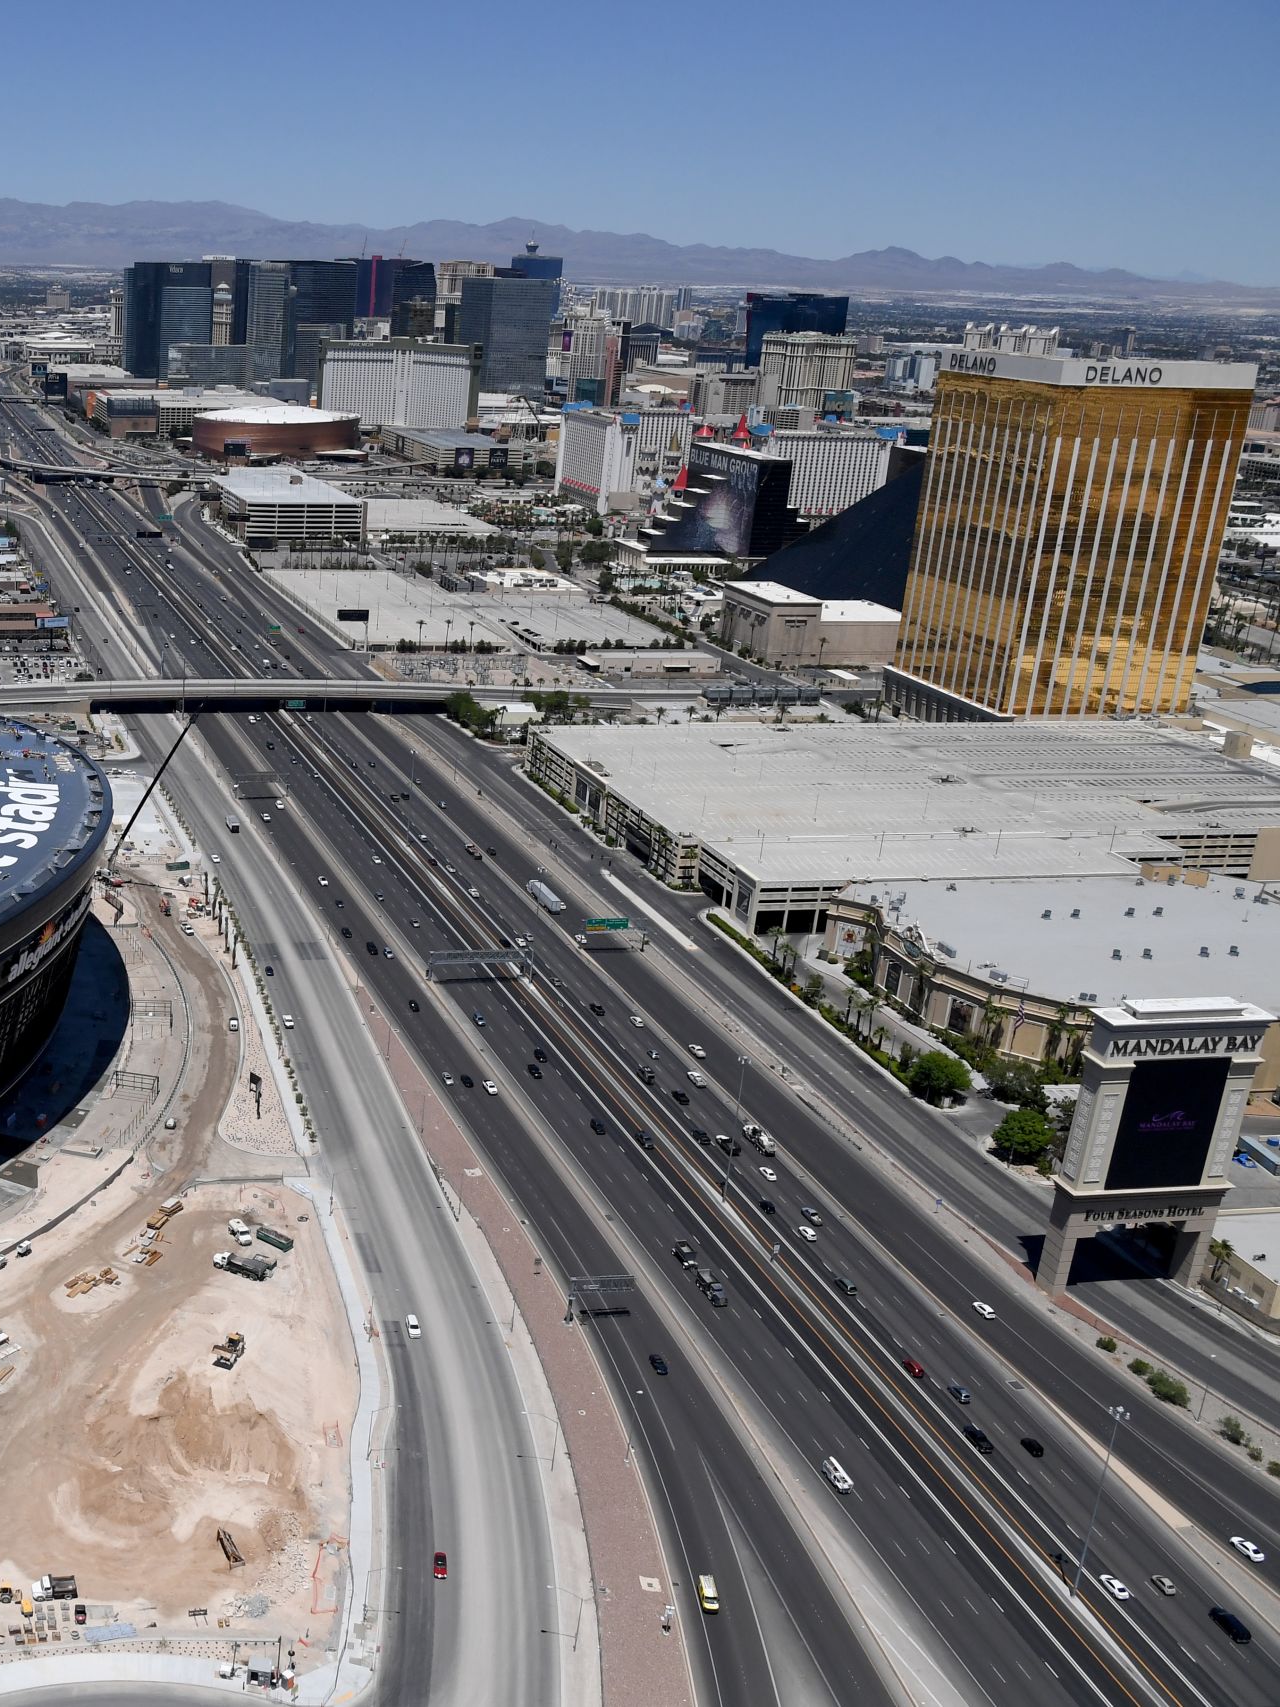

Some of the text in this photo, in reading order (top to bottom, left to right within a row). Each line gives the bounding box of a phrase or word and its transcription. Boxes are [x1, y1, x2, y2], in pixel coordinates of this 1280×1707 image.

[950, 353, 996, 374] DELANO
[1085, 366, 1163, 384] DELANO
[825, 401, 854, 412] MGM
[690, 448, 758, 476] BLUE MAN GROUP
[8, 923, 64, 982] allegiant
[1110, 1035, 1263, 1058] MANDALAY BAY
[1084, 1205, 1205, 1222] FOUR SEASONS HOTEL
